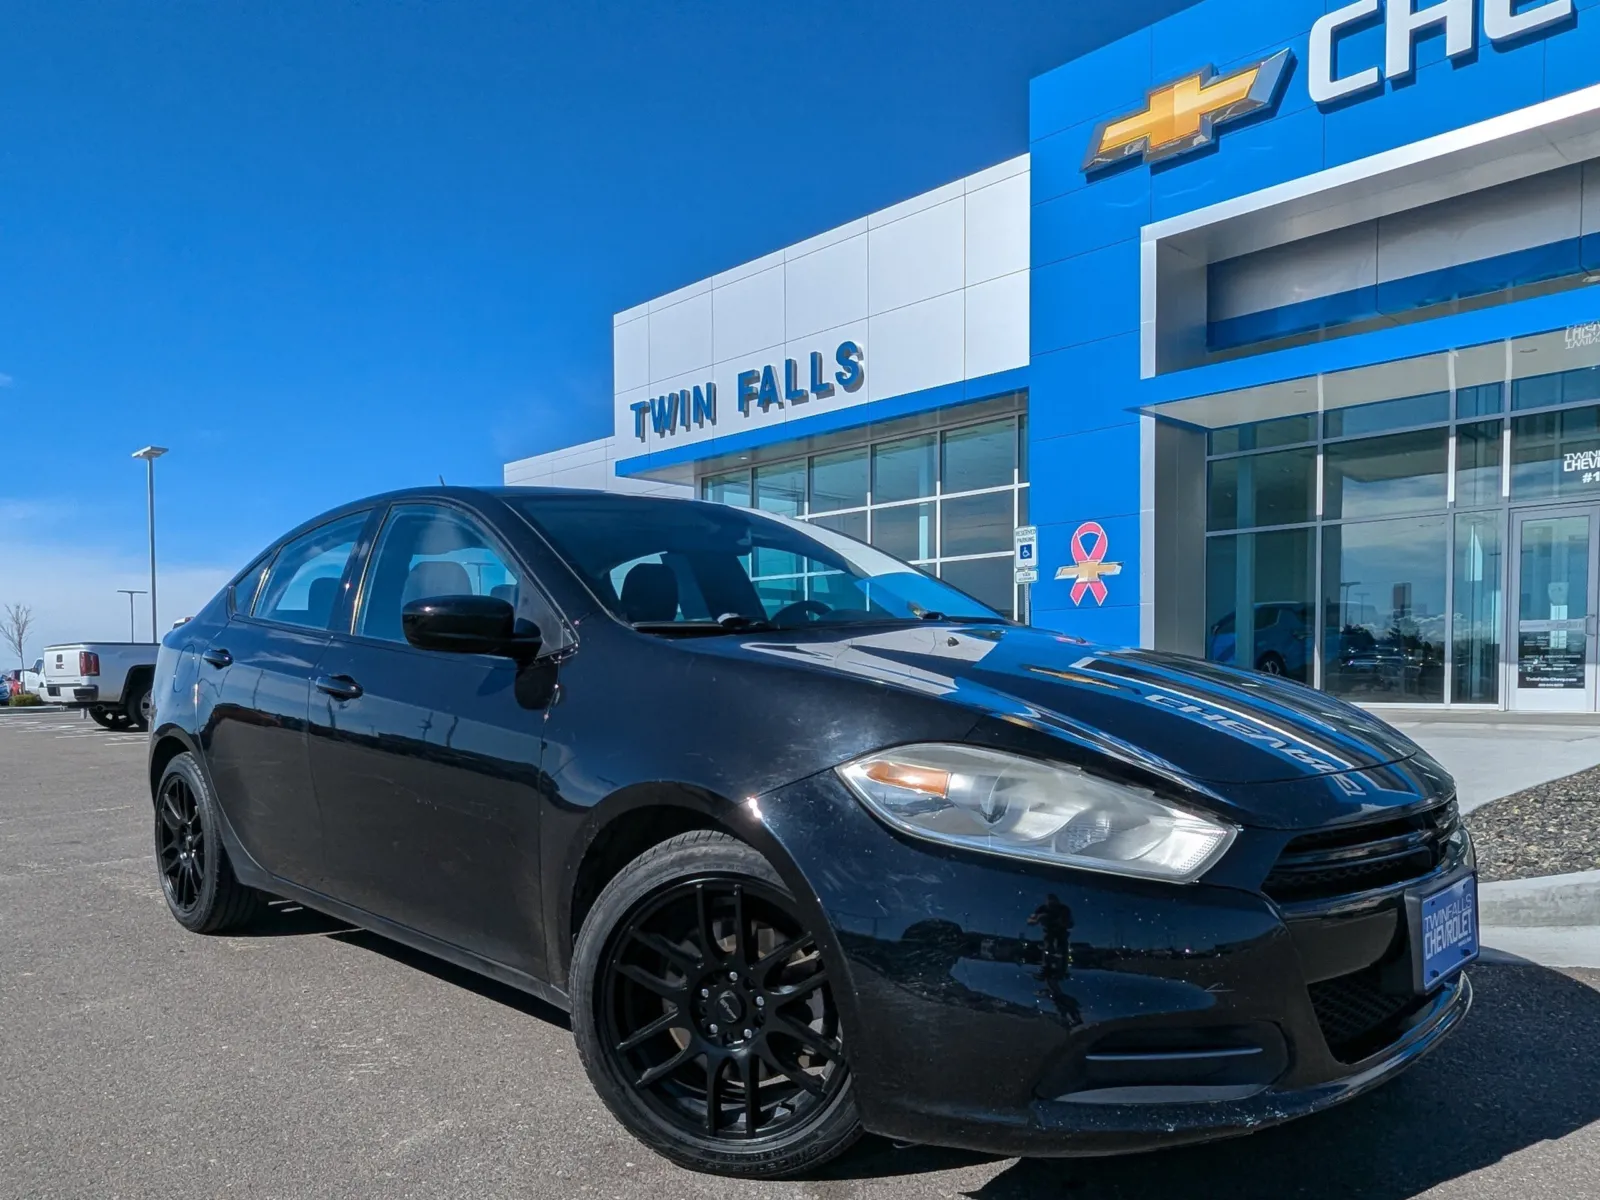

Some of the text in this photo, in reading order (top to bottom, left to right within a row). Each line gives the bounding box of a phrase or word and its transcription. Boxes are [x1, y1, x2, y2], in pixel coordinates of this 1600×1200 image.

[630, 340, 865, 443] TWIN FALLS
[1424, 908, 1472, 960] CHEVROLET
